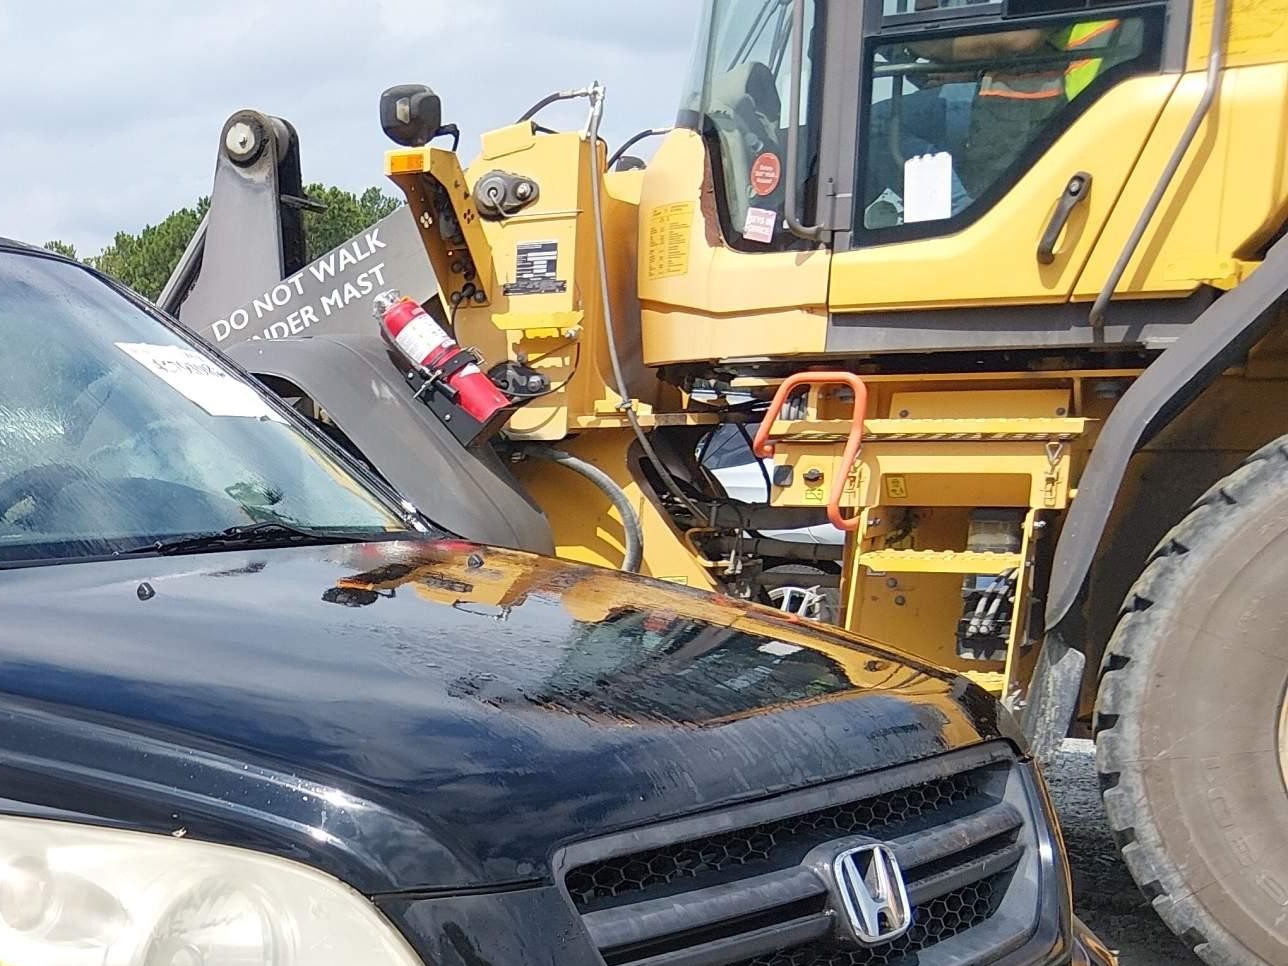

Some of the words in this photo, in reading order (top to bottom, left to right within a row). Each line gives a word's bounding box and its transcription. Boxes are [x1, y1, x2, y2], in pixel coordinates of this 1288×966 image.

[212, 309, 249, 342] DO
[253, 272, 304, 318] NOT
[309, 228, 387, 283] WALK
[247, 305, 320, 341] NDER
[320, 263, 385, 316] MAST
